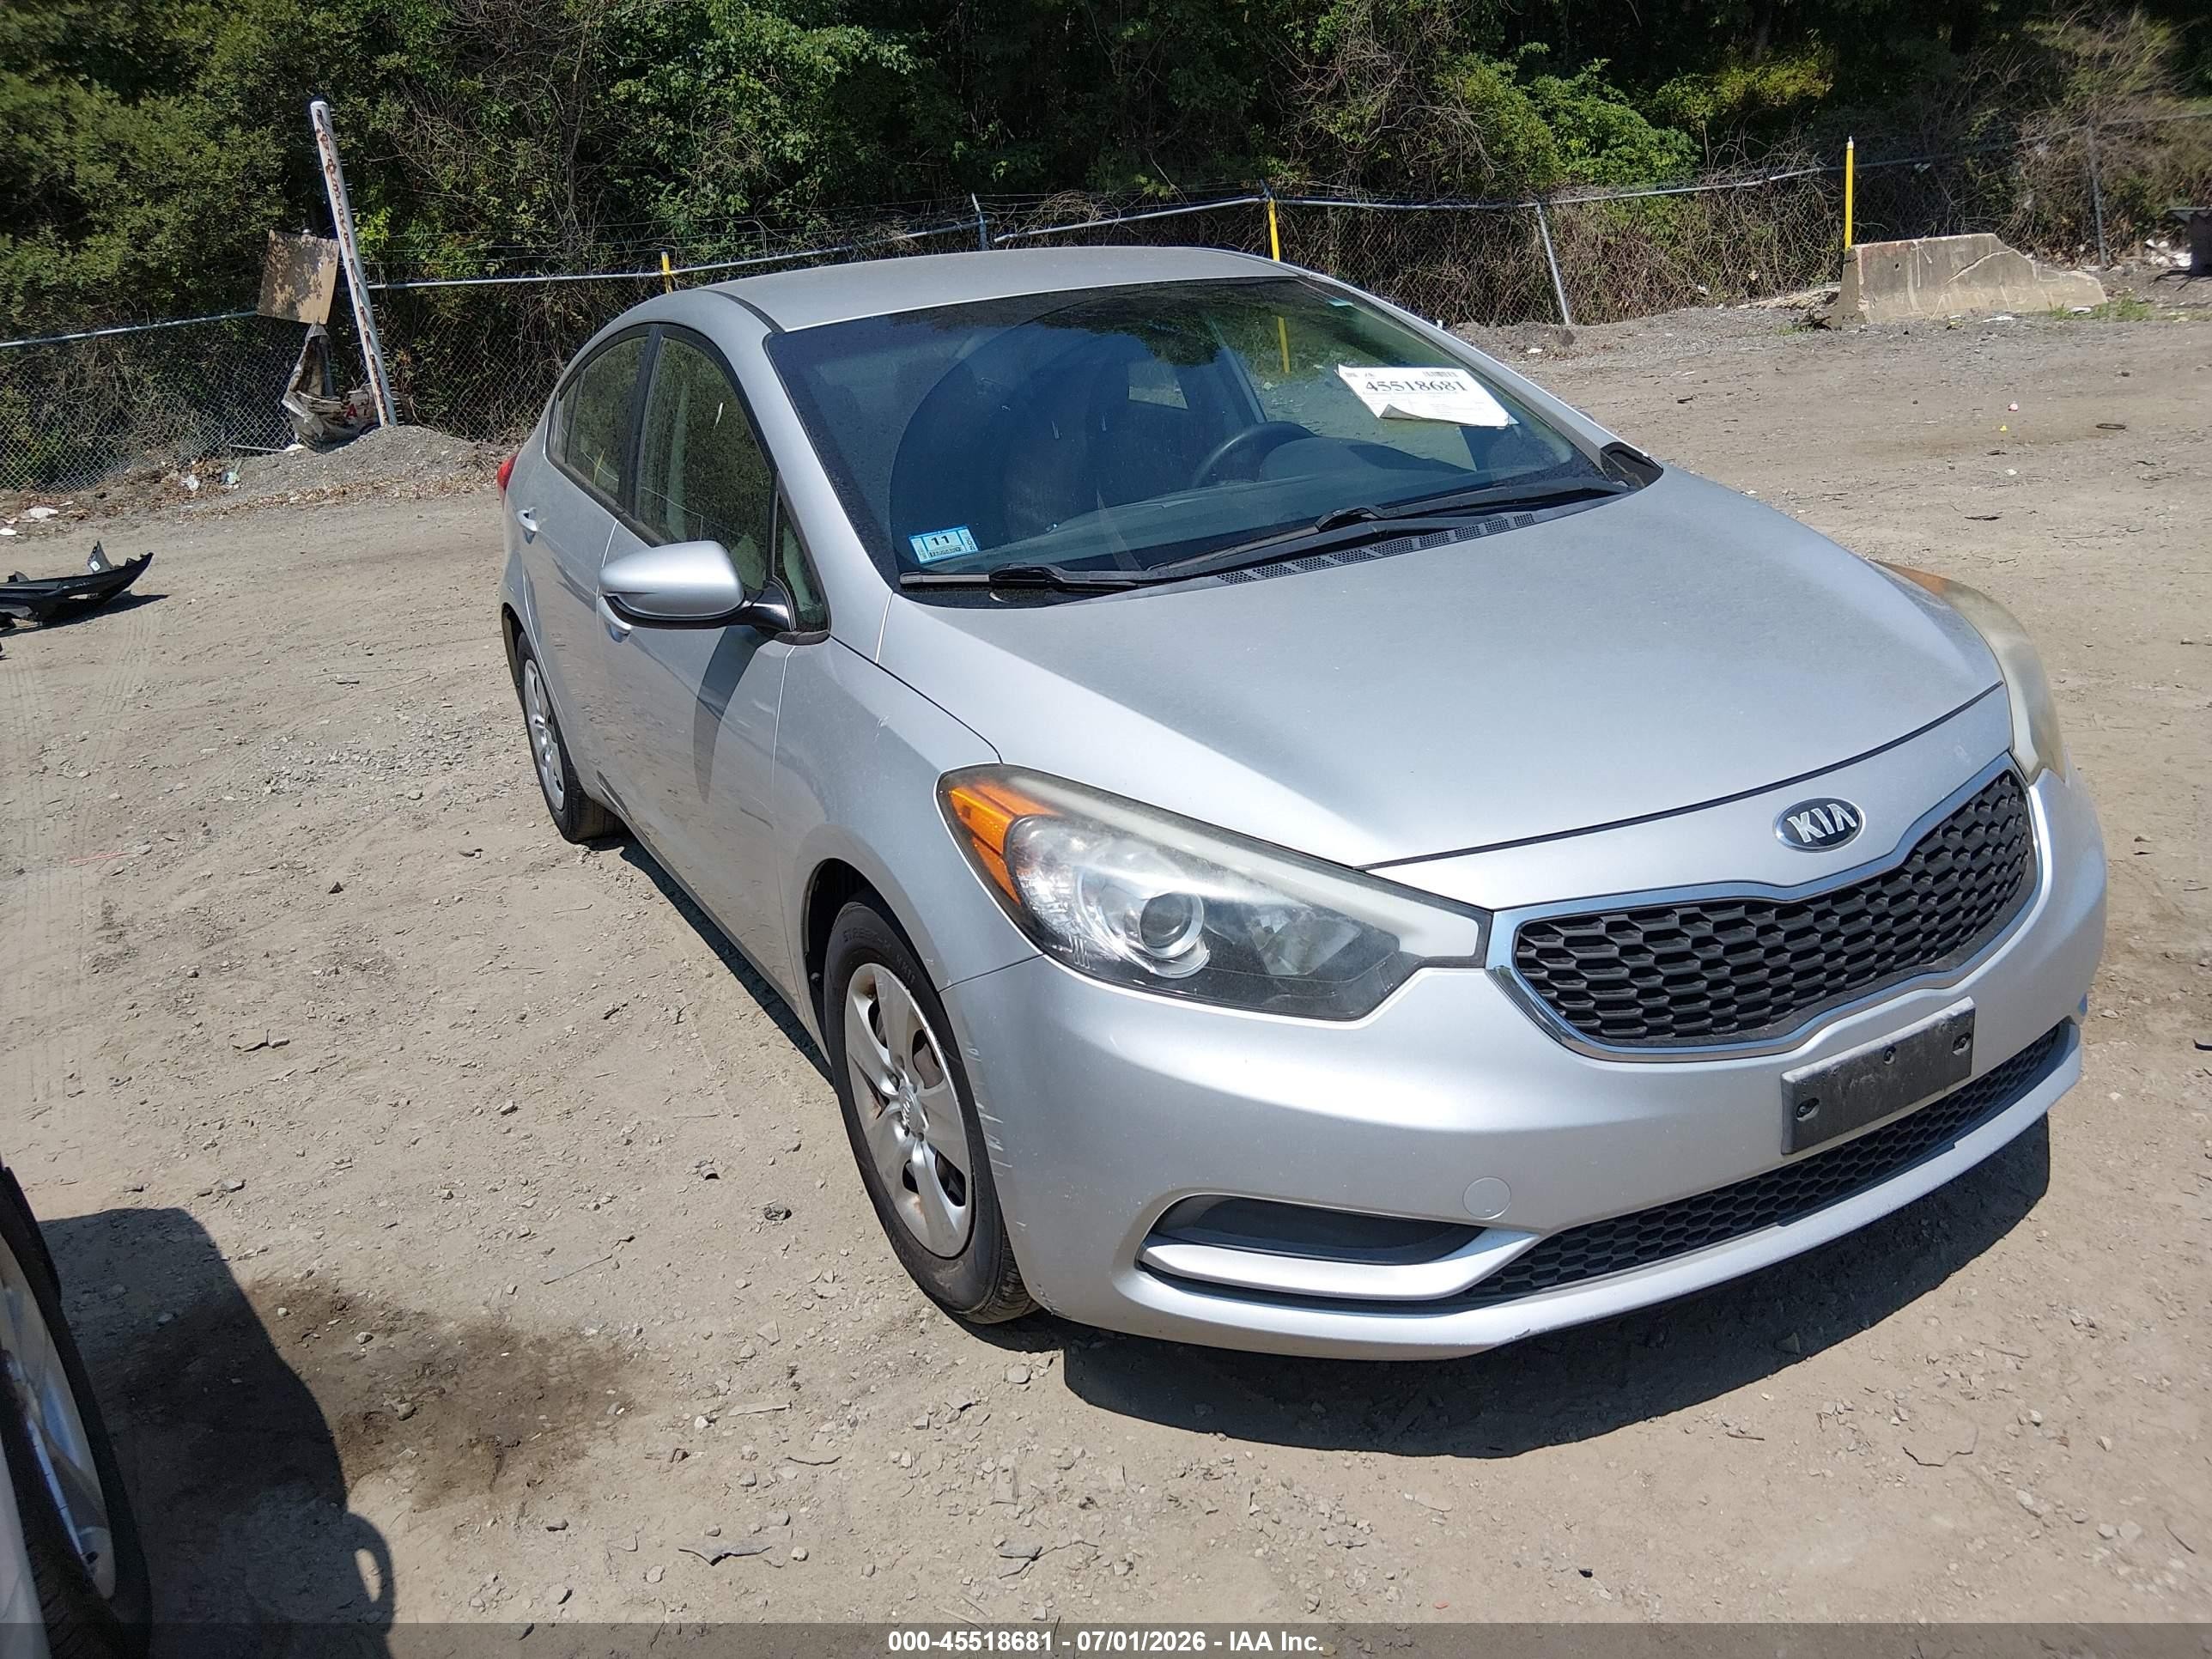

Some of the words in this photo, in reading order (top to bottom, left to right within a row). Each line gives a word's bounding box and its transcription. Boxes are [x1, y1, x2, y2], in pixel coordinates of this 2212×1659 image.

[1365, 380, 1468, 392] 45518681
[931, 535, 950, 546] 11
[1787, 803, 1857, 843] KIA
